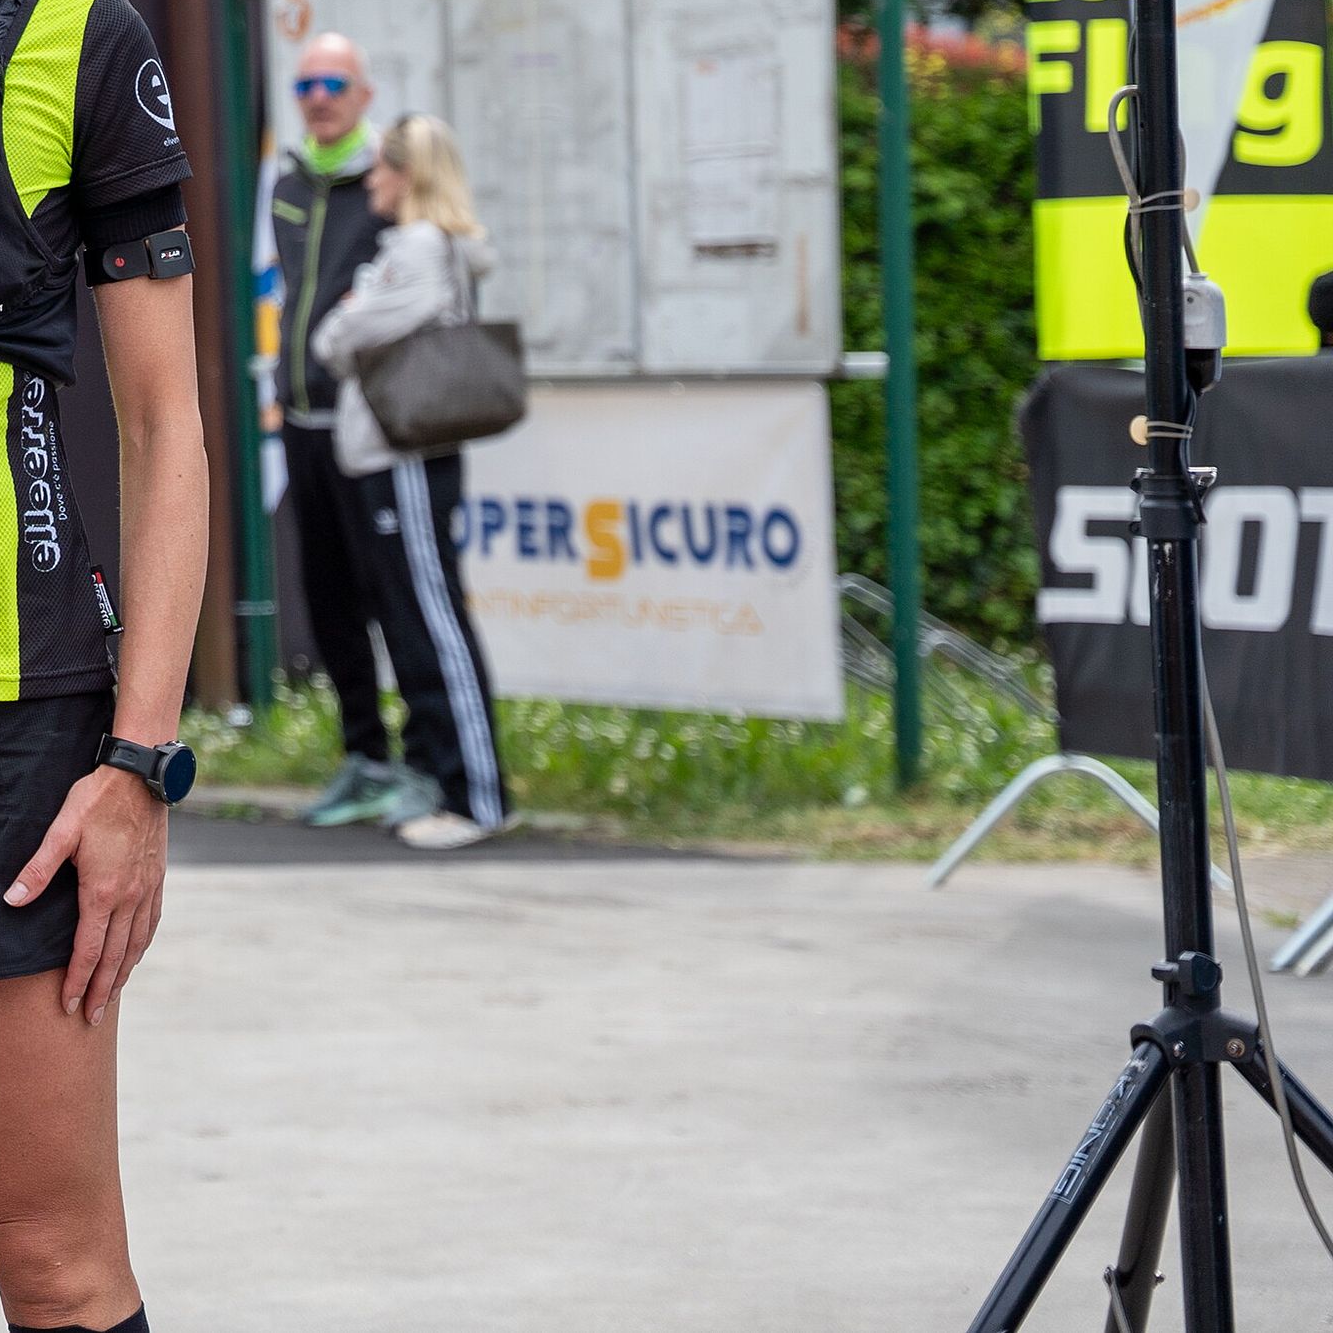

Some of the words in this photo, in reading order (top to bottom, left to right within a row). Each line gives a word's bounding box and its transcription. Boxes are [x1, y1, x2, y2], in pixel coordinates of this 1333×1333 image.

[160, 249, 181, 259] POLAR
[48, 420, 61, 471] passione
[21, 375, 62, 573] elleerre
[56, 492, 68, 521] Dove
